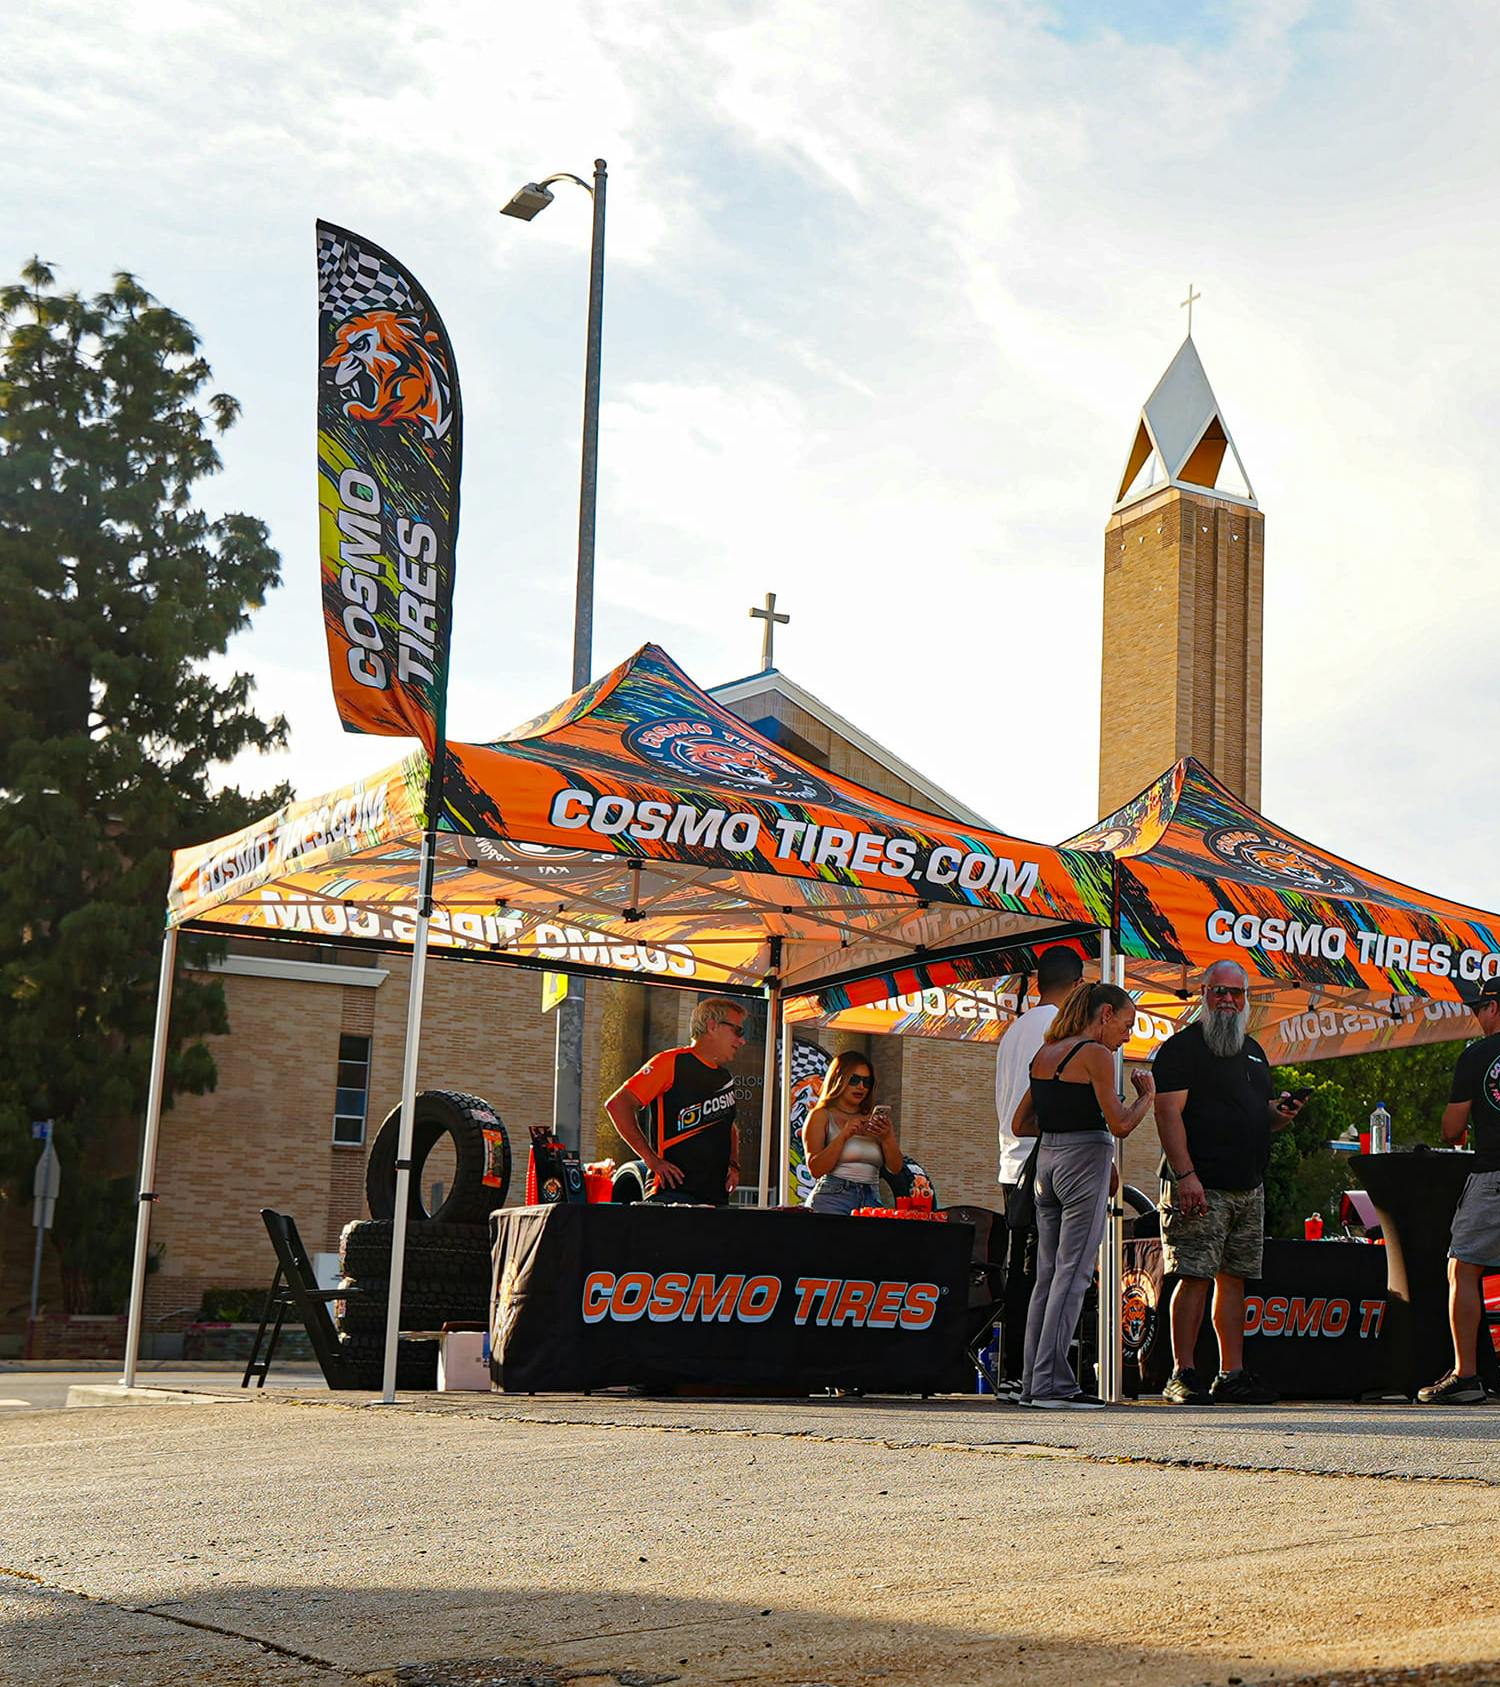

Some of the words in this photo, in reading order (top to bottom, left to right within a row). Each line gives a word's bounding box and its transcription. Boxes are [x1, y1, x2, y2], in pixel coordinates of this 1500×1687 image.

[338, 468, 387, 690] COSMO
[397, 522, 438, 685] TIRES
[550, 788, 761, 853] COSMO
[775, 818, 1040, 898] TIRES.COM
[1206, 910, 1348, 961] COSMO
[582, 1271, 782, 1325] COSMO
[794, 1277, 942, 1331] TIRES
[1243, 1296, 1351, 1338] OSMO
